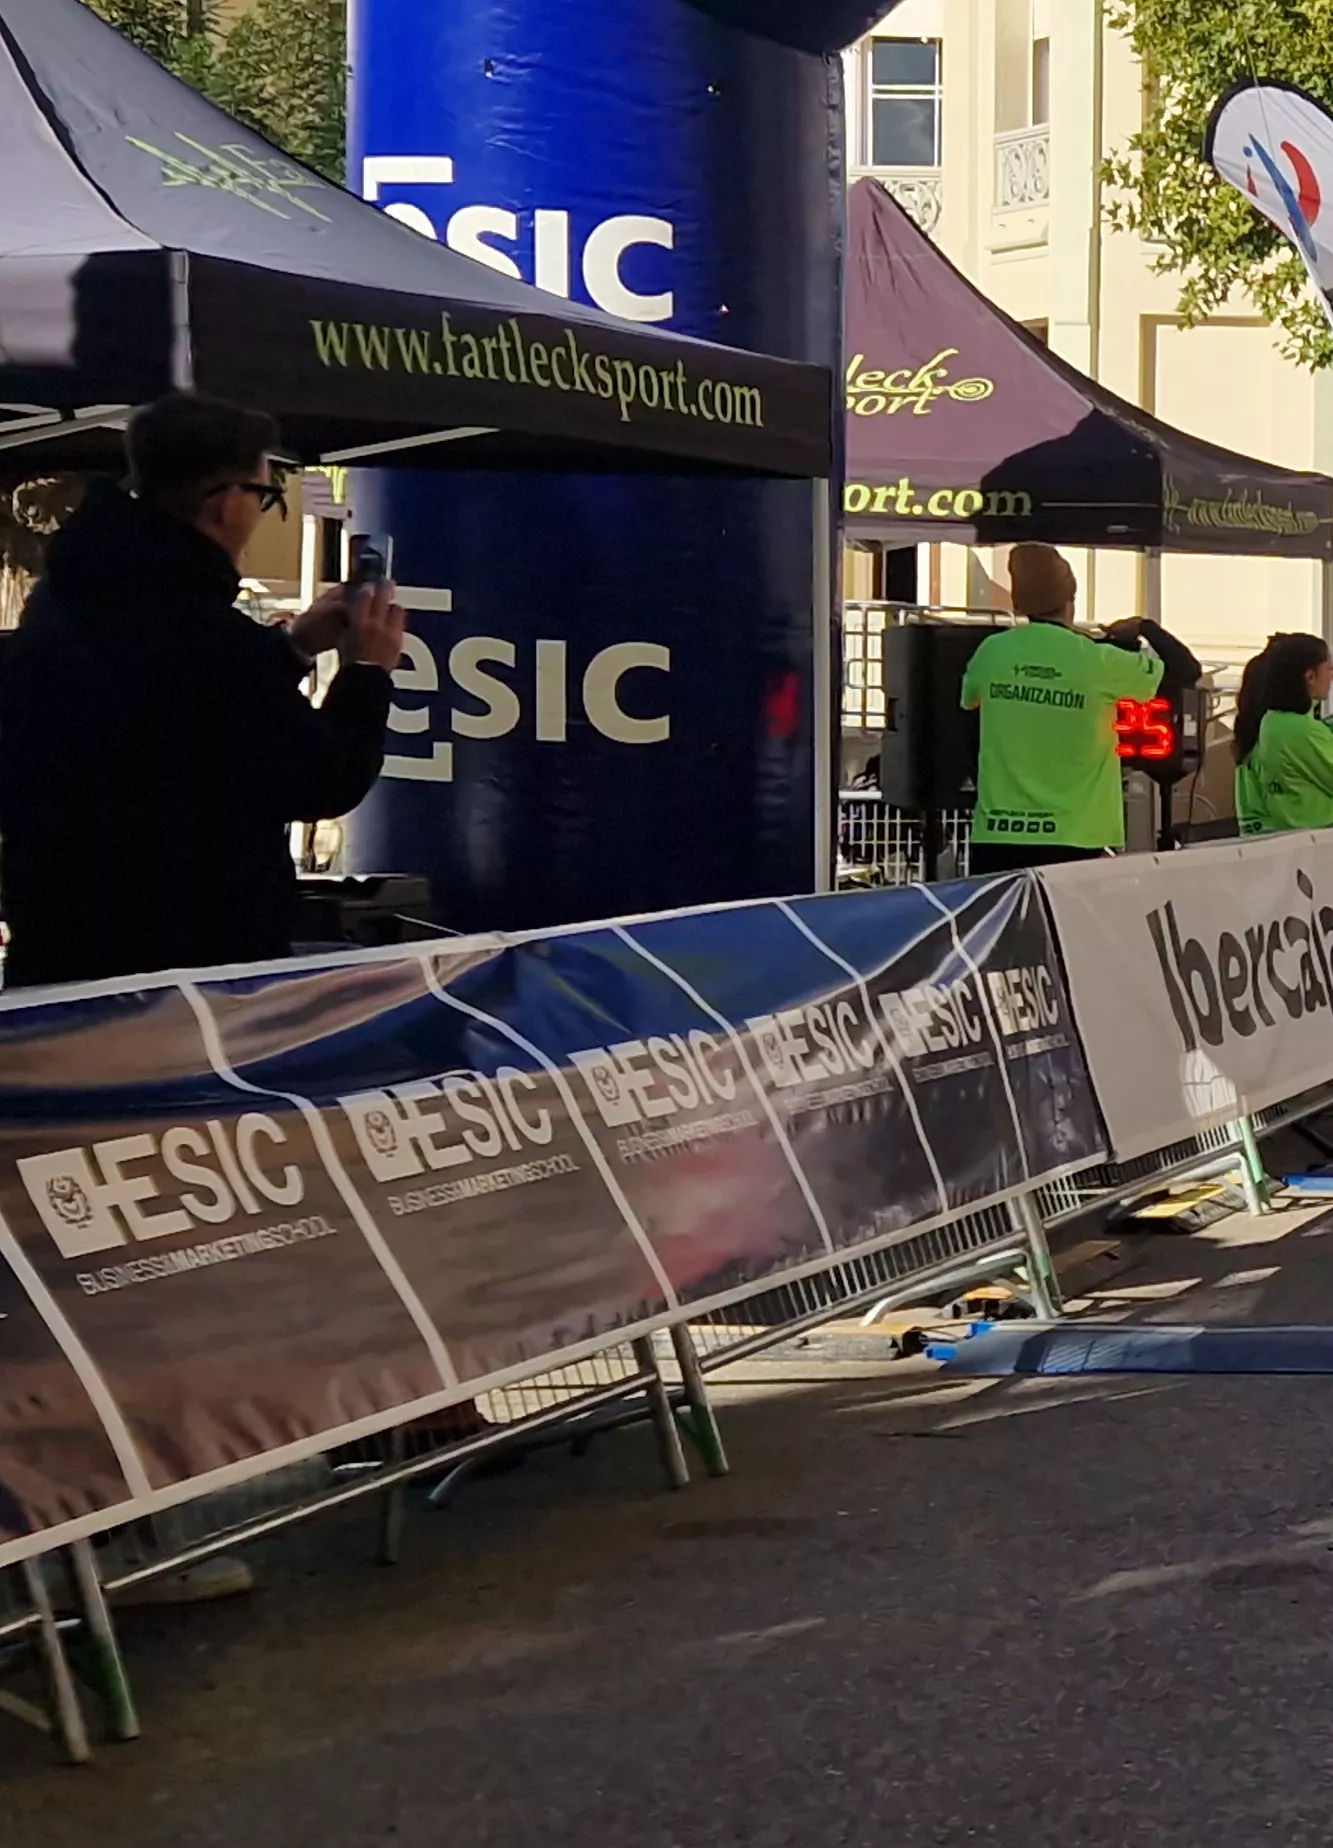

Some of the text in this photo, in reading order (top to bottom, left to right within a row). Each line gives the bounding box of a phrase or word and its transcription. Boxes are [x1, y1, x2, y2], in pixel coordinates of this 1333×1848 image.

[309, 313, 763, 427] www.fartlecksport.com
[777, 1000, 875, 1083] ESIC
[900, 980, 981, 1052] ESIC
[1004, 965, 1059, 1033] ESIC
[400, 1066, 552, 1174] ESIC
[614, 1029, 738, 1120] ESIC
[92, 1112, 303, 1242] ESIC
